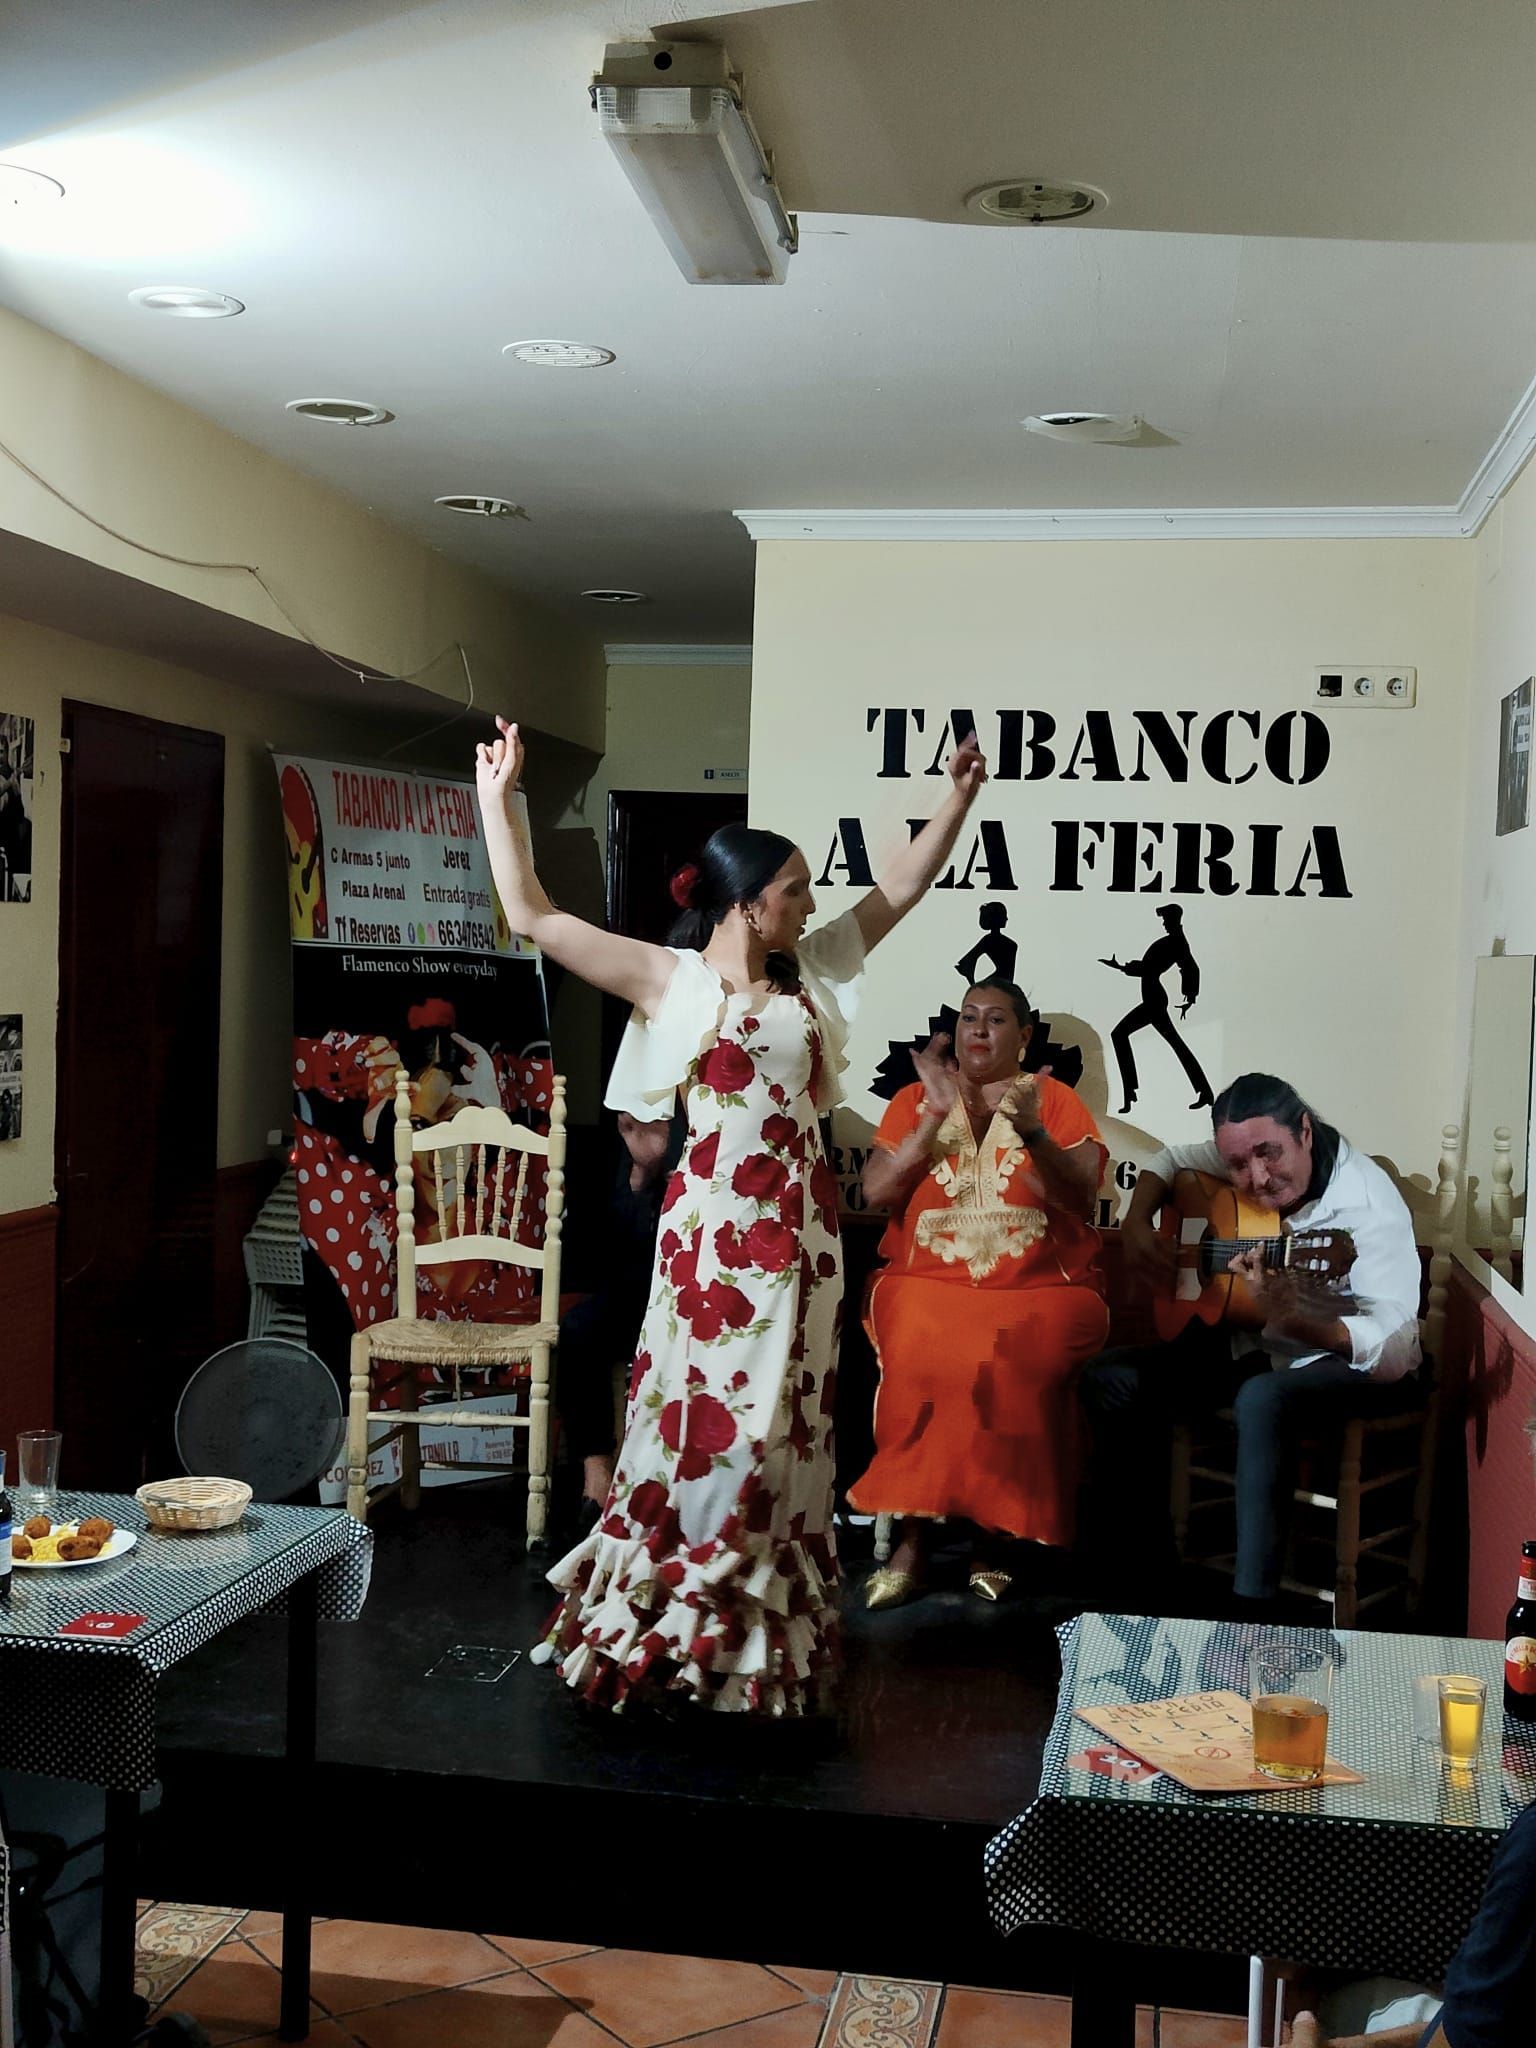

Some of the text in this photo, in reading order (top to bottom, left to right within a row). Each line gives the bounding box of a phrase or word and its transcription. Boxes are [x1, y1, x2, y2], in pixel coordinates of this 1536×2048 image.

[866, 708, 1331, 785] TABANCO
[332, 770, 478, 840] TABANCO A LA FERIA
[330, 847, 411, 872] C Armas 5 junto
[442, 845, 471, 871] Jerez
[815, 818, 877, 887] A
[1050, 820, 1353, 898] FERIA
[342, 880, 406, 901] Plaza Arenal
[423, 883, 491, 910] Entrada gratis
[350, 917, 401, 944] Reservas
[342, 955, 410, 973] Flamenco
[412, 956, 450, 974] Show
